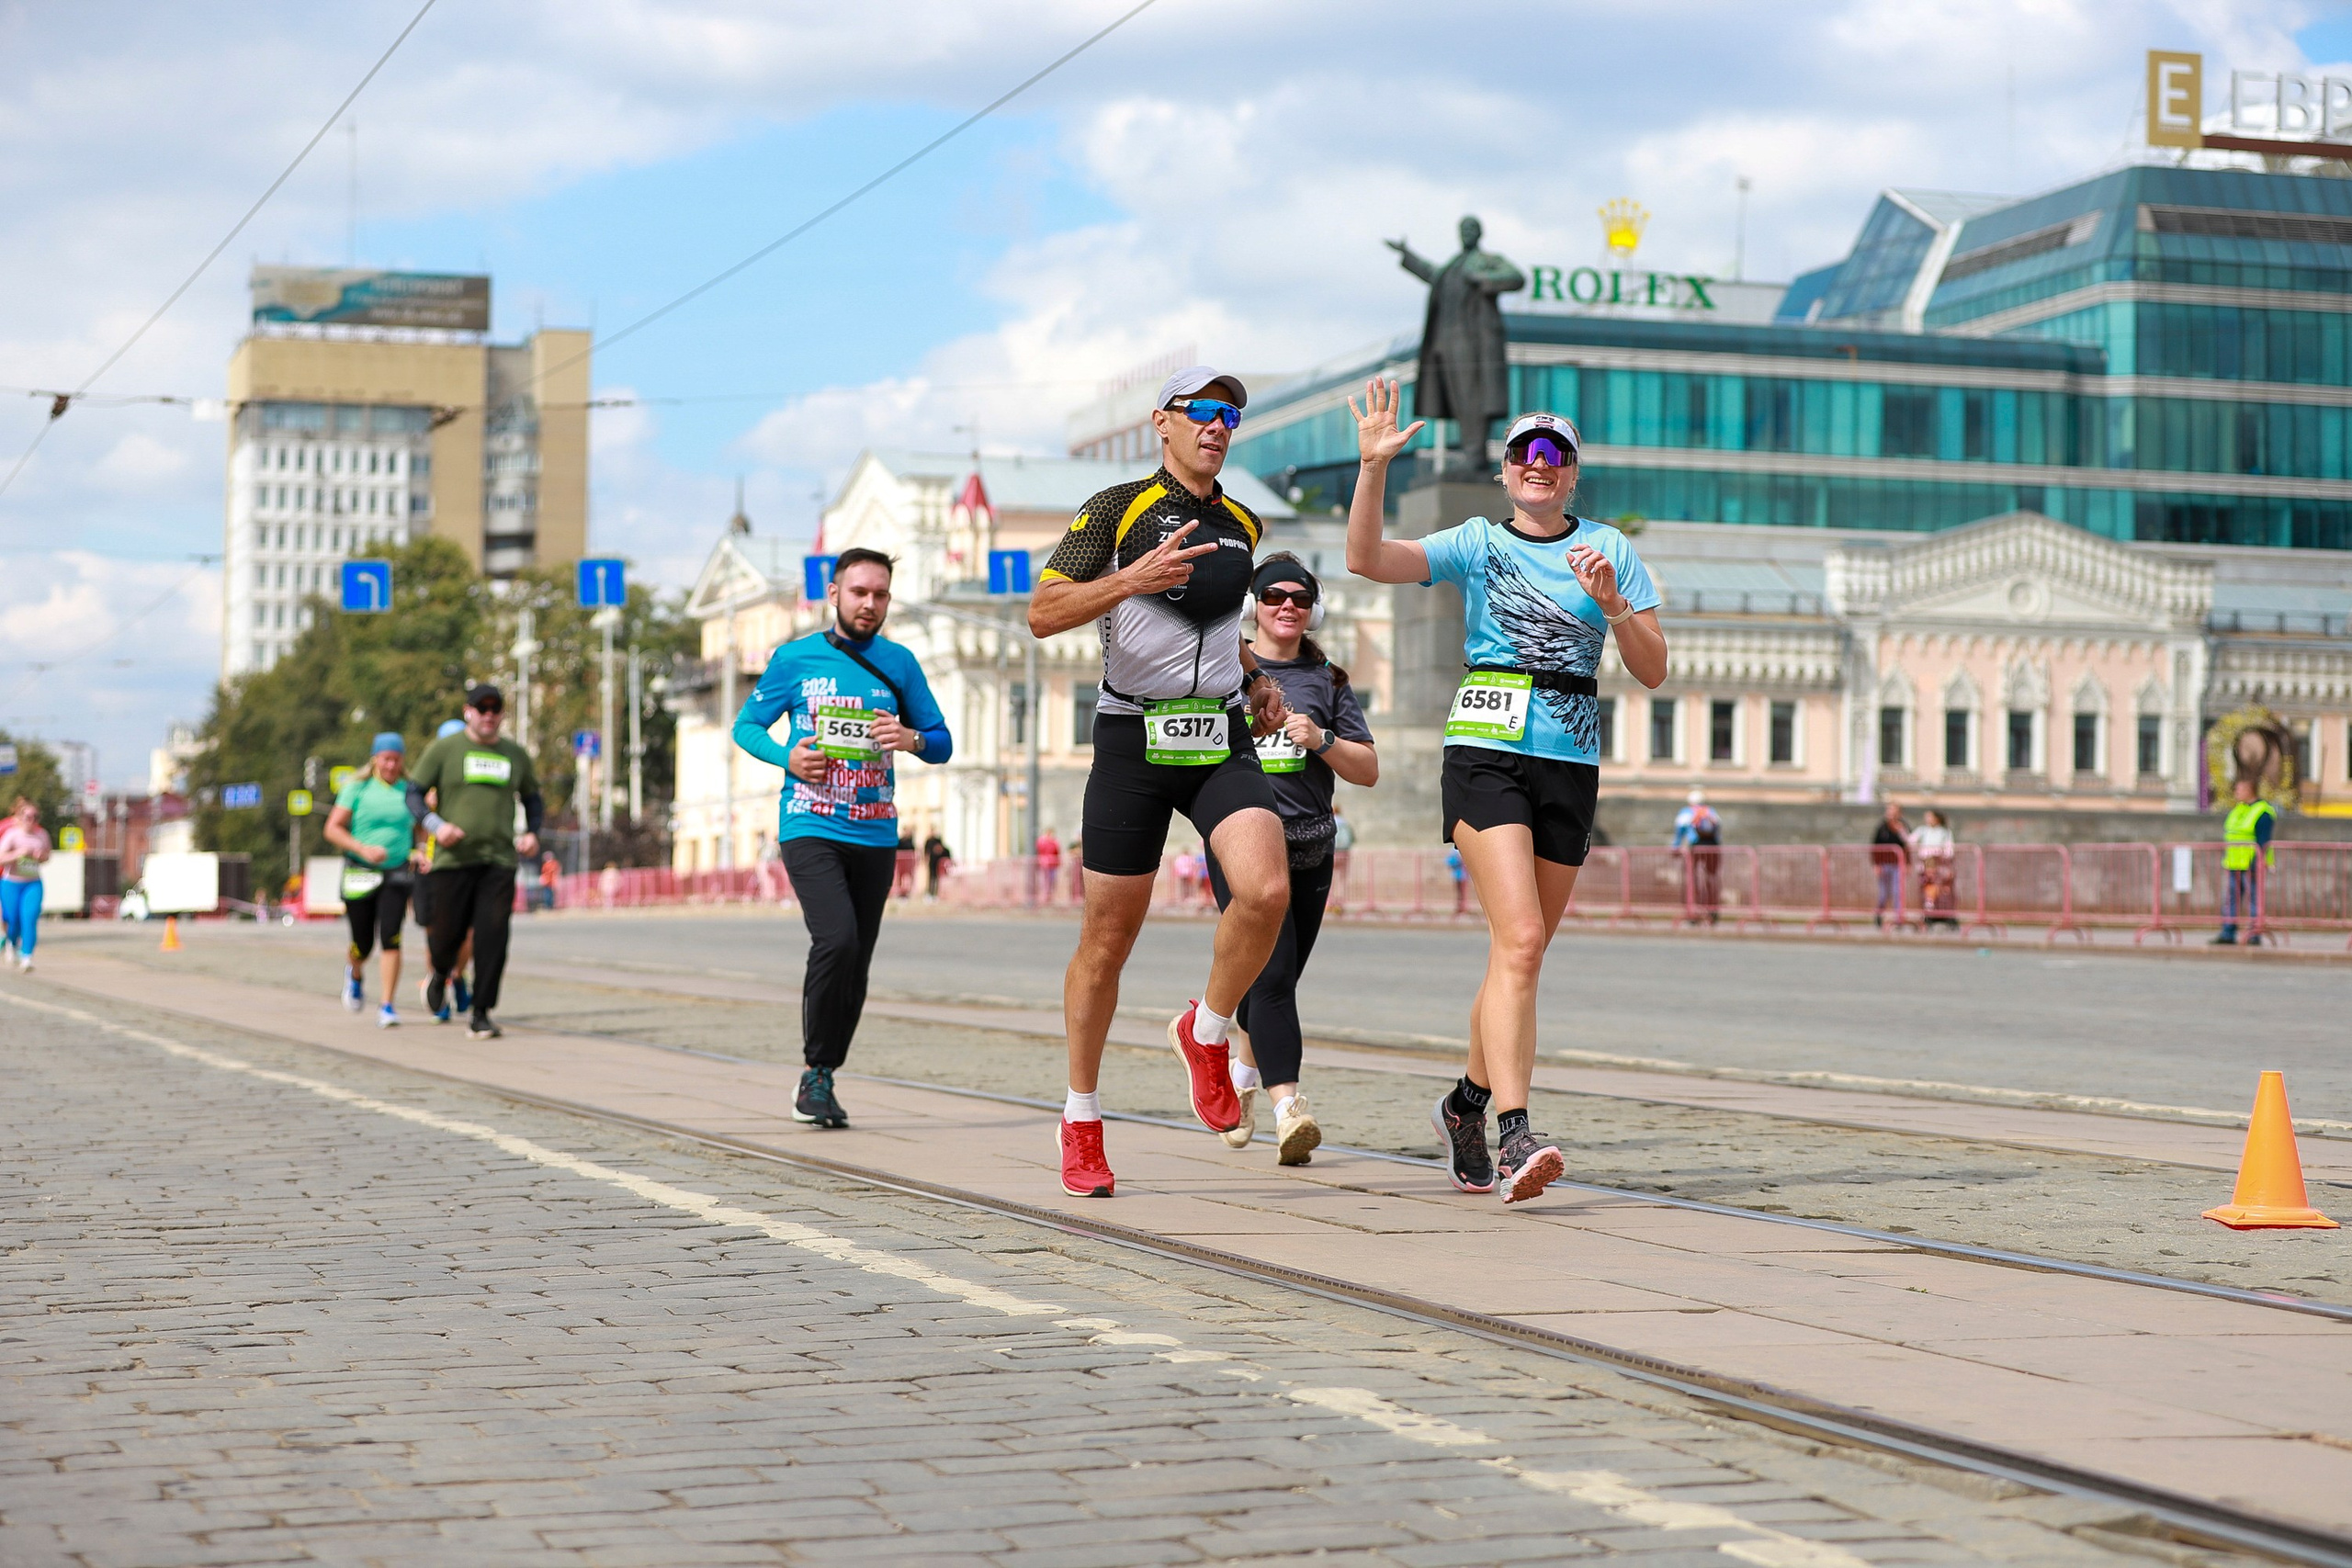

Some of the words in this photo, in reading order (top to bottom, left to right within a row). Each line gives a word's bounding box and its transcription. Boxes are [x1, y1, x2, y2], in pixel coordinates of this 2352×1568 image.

[1531, 265, 1715, 310] ROLEX
[801, 677, 838, 697] 2024
[1461, 689, 1512, 712] 6581
[1163, 717, 1216, 738] 6317
[1508, 716, 1518, 729] E
[1213, 732, 1224, 745] D
[1255, 730, 1295, 748] 275
